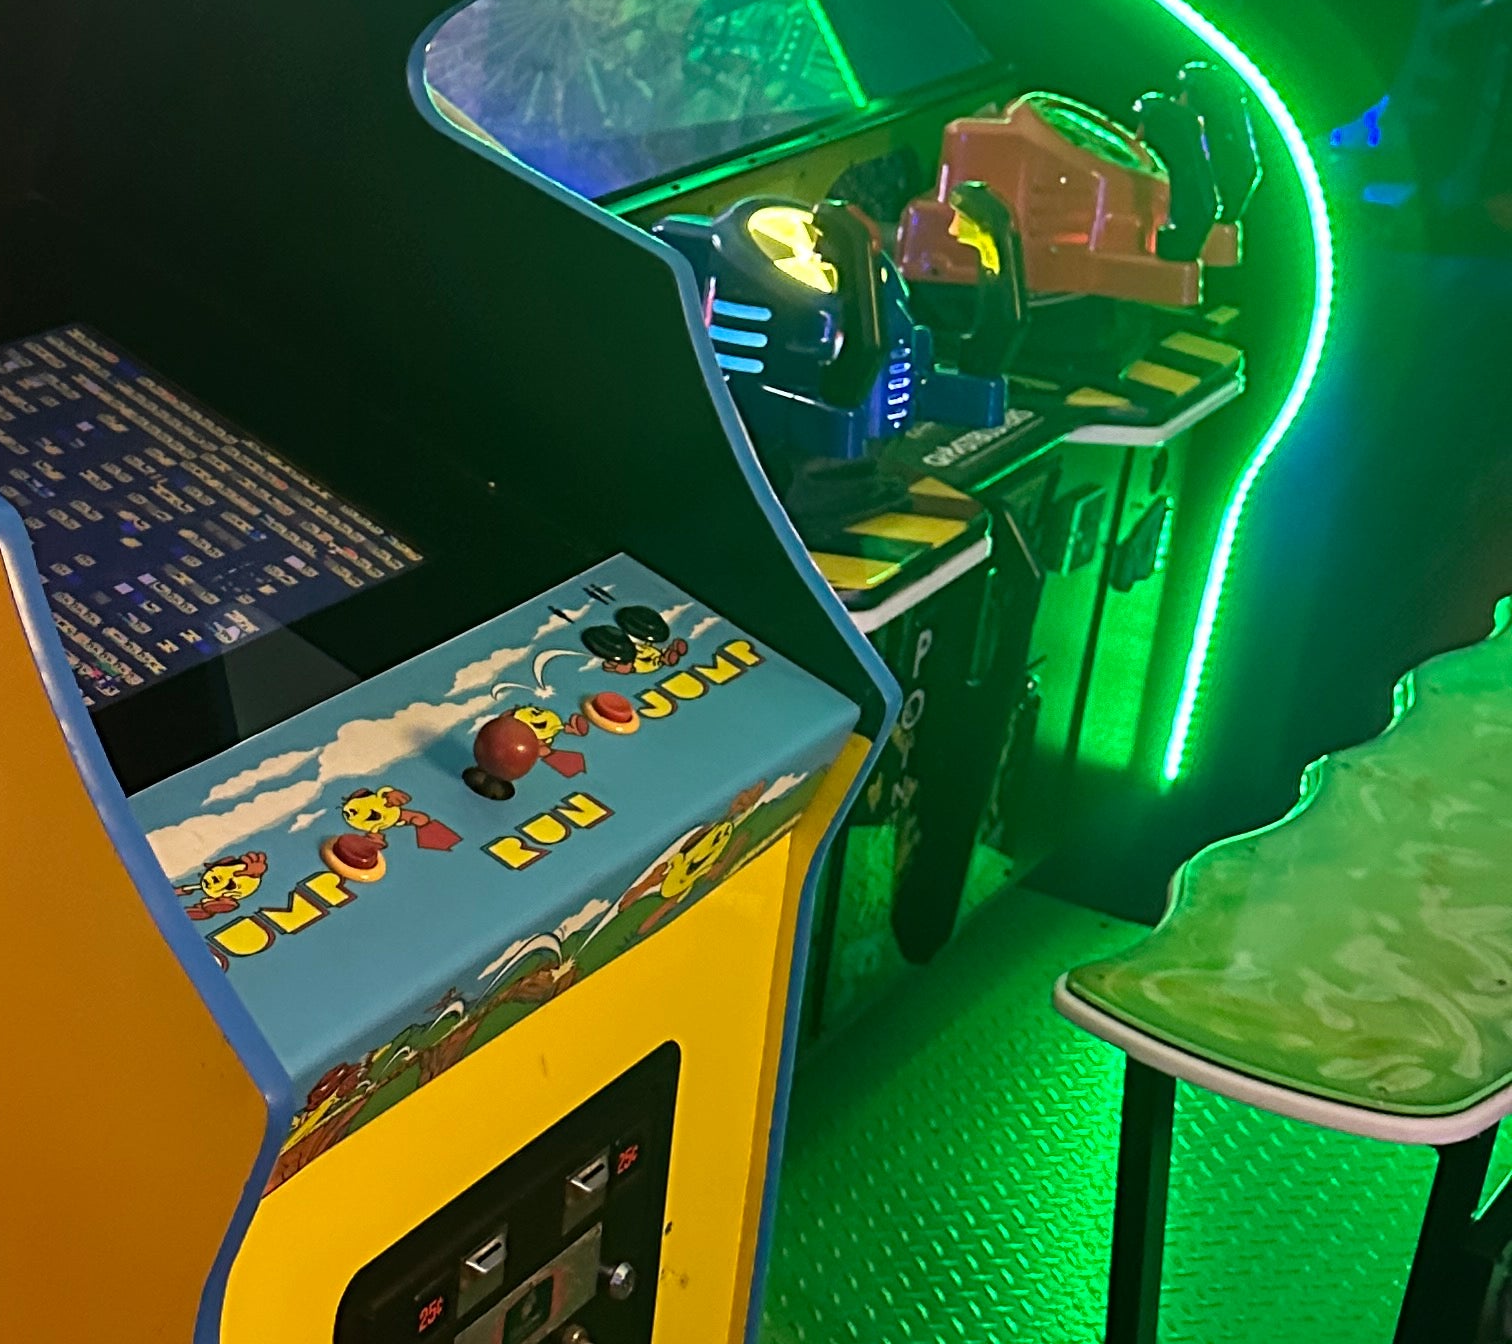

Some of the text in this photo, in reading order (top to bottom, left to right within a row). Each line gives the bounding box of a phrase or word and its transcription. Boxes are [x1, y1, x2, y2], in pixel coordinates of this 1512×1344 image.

[635, 639, 766, 719] JUMP
[480, 792, 615, 871] RUN
[616, 1144, 638, 1175] 25¢
[418, 1296, 444, 1333] 25¢
